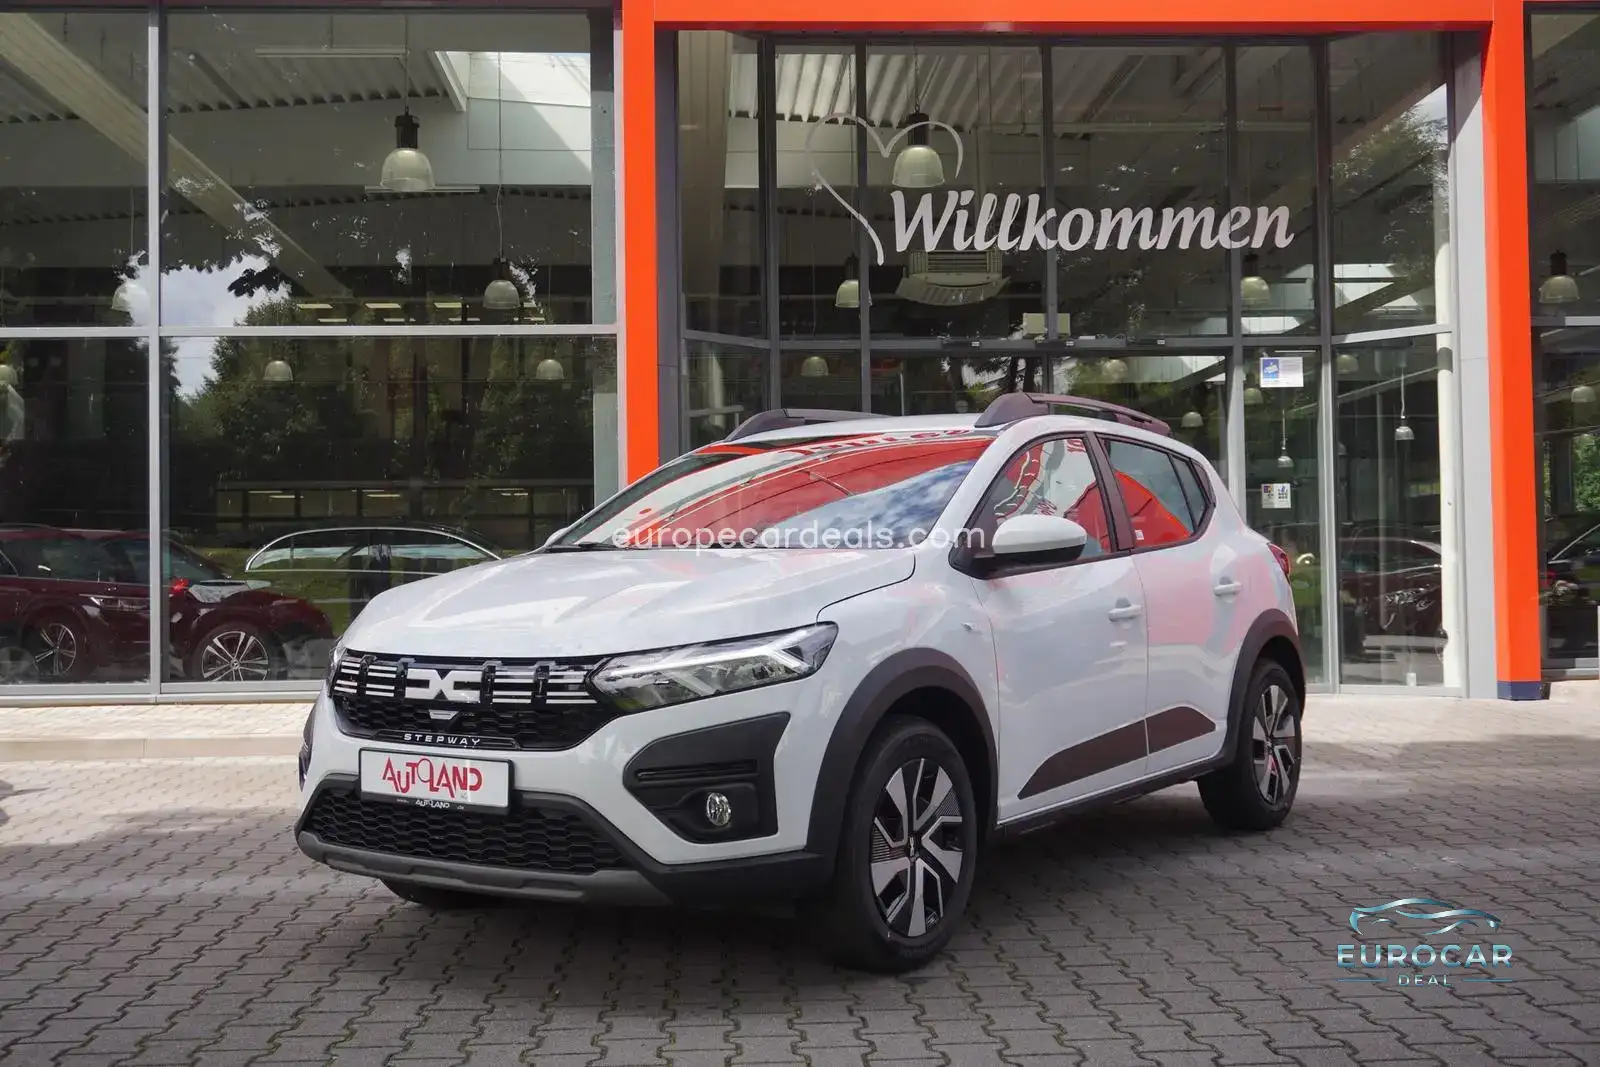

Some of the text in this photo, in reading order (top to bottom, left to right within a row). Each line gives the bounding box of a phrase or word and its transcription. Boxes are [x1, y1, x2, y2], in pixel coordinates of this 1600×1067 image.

[891, 190, 1295, 252] Willkommen
[404, 733, 480, 745] STEPWAY
[382, 757, 482, 798] AUTOLAND
